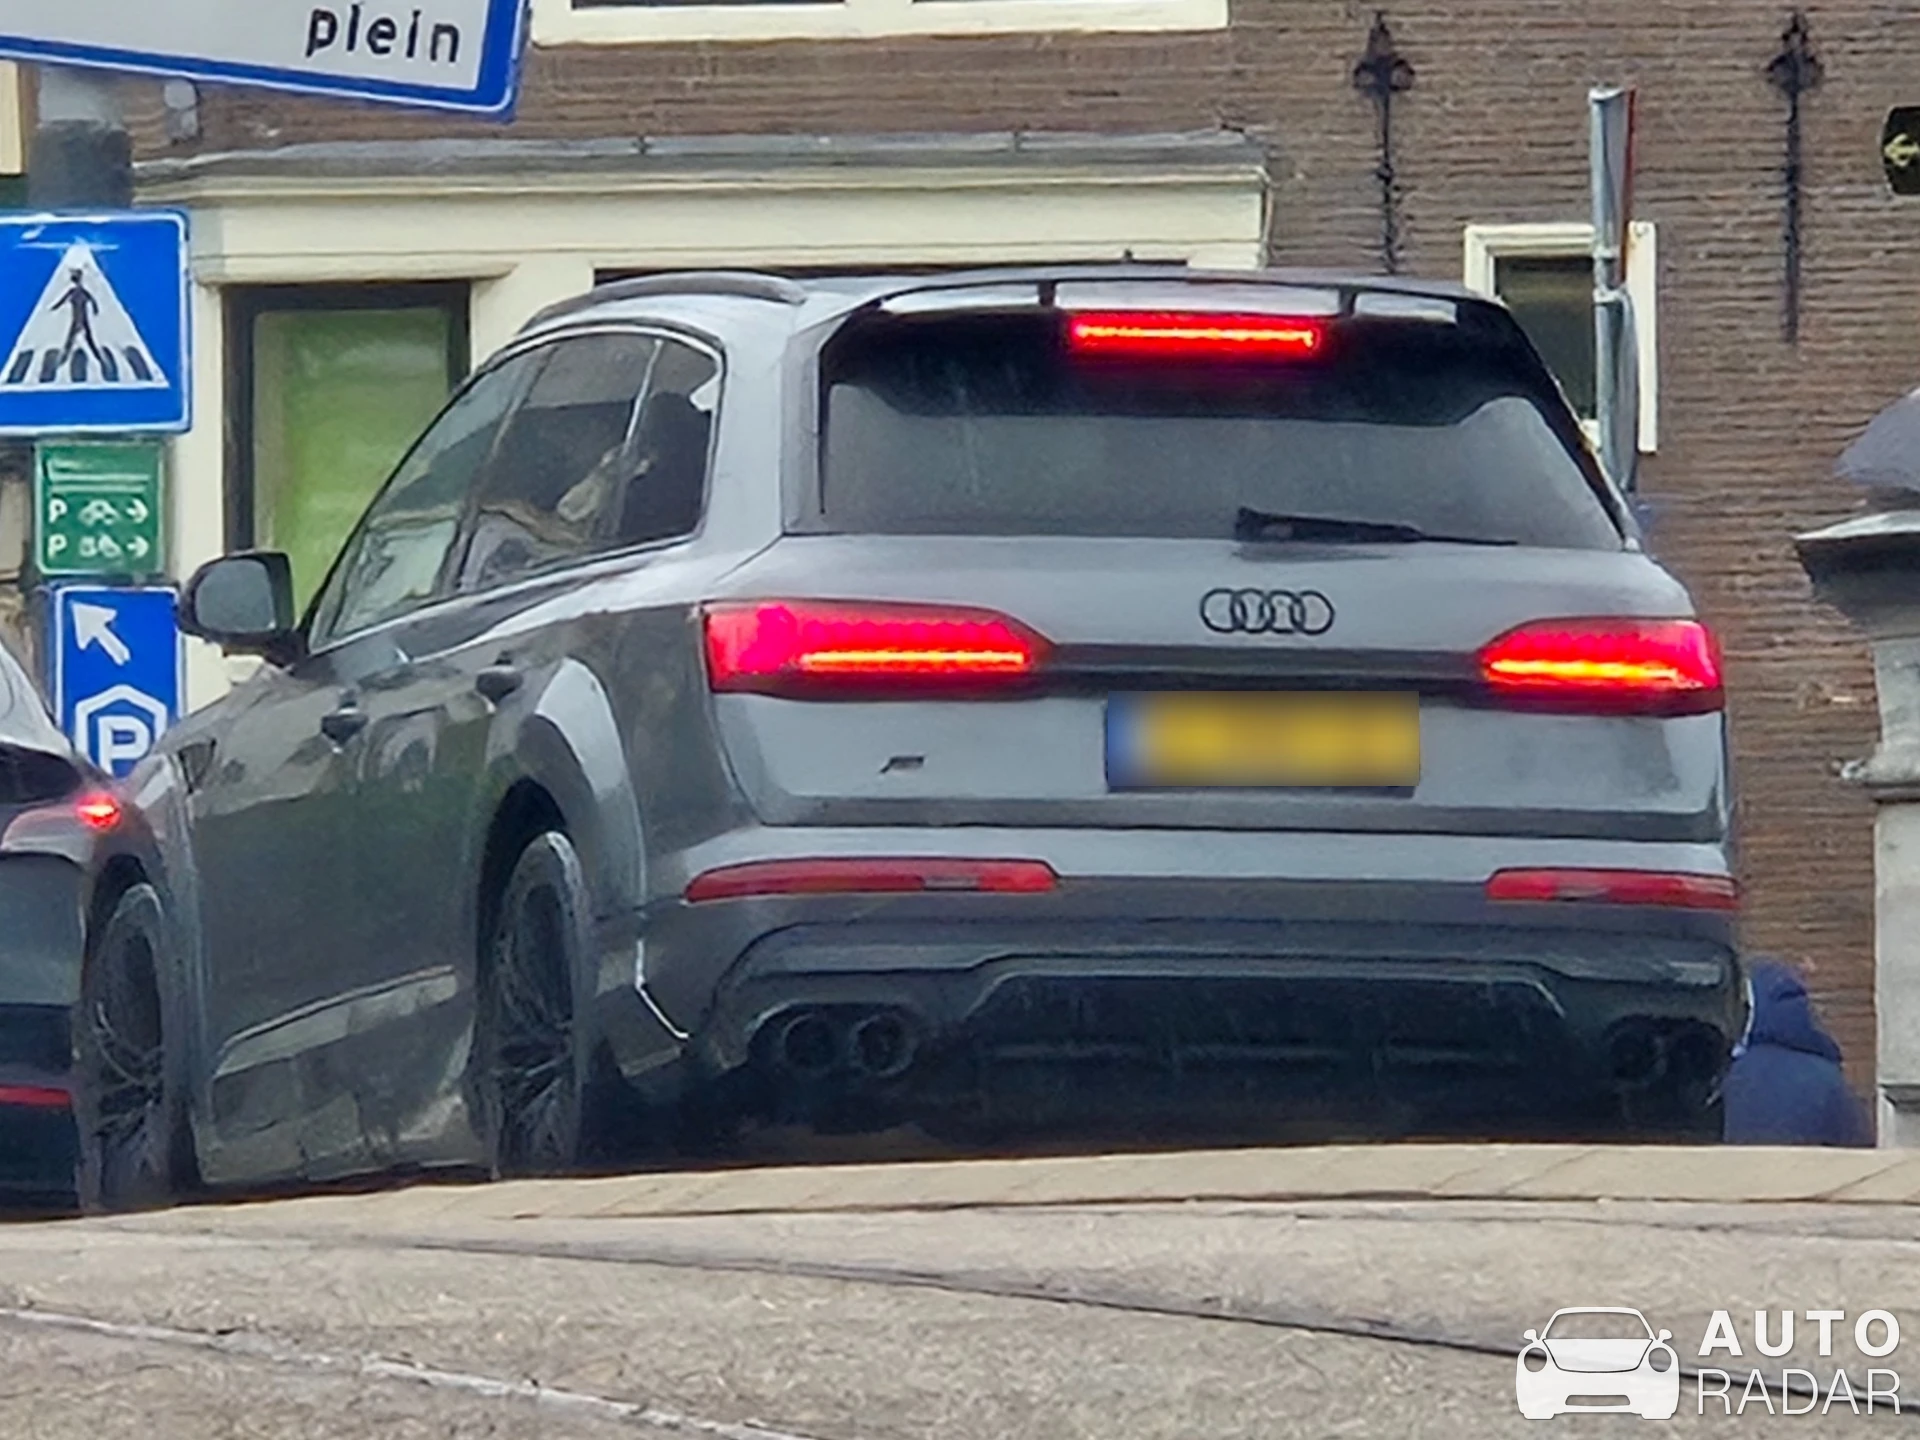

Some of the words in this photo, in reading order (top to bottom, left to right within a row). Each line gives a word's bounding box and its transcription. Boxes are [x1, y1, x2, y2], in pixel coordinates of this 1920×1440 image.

[305, 3, 460, 63] plein
[48, 498, 68, 524] P
[47, 533, 68, 559] P
[97, 715, 150, 777] P
